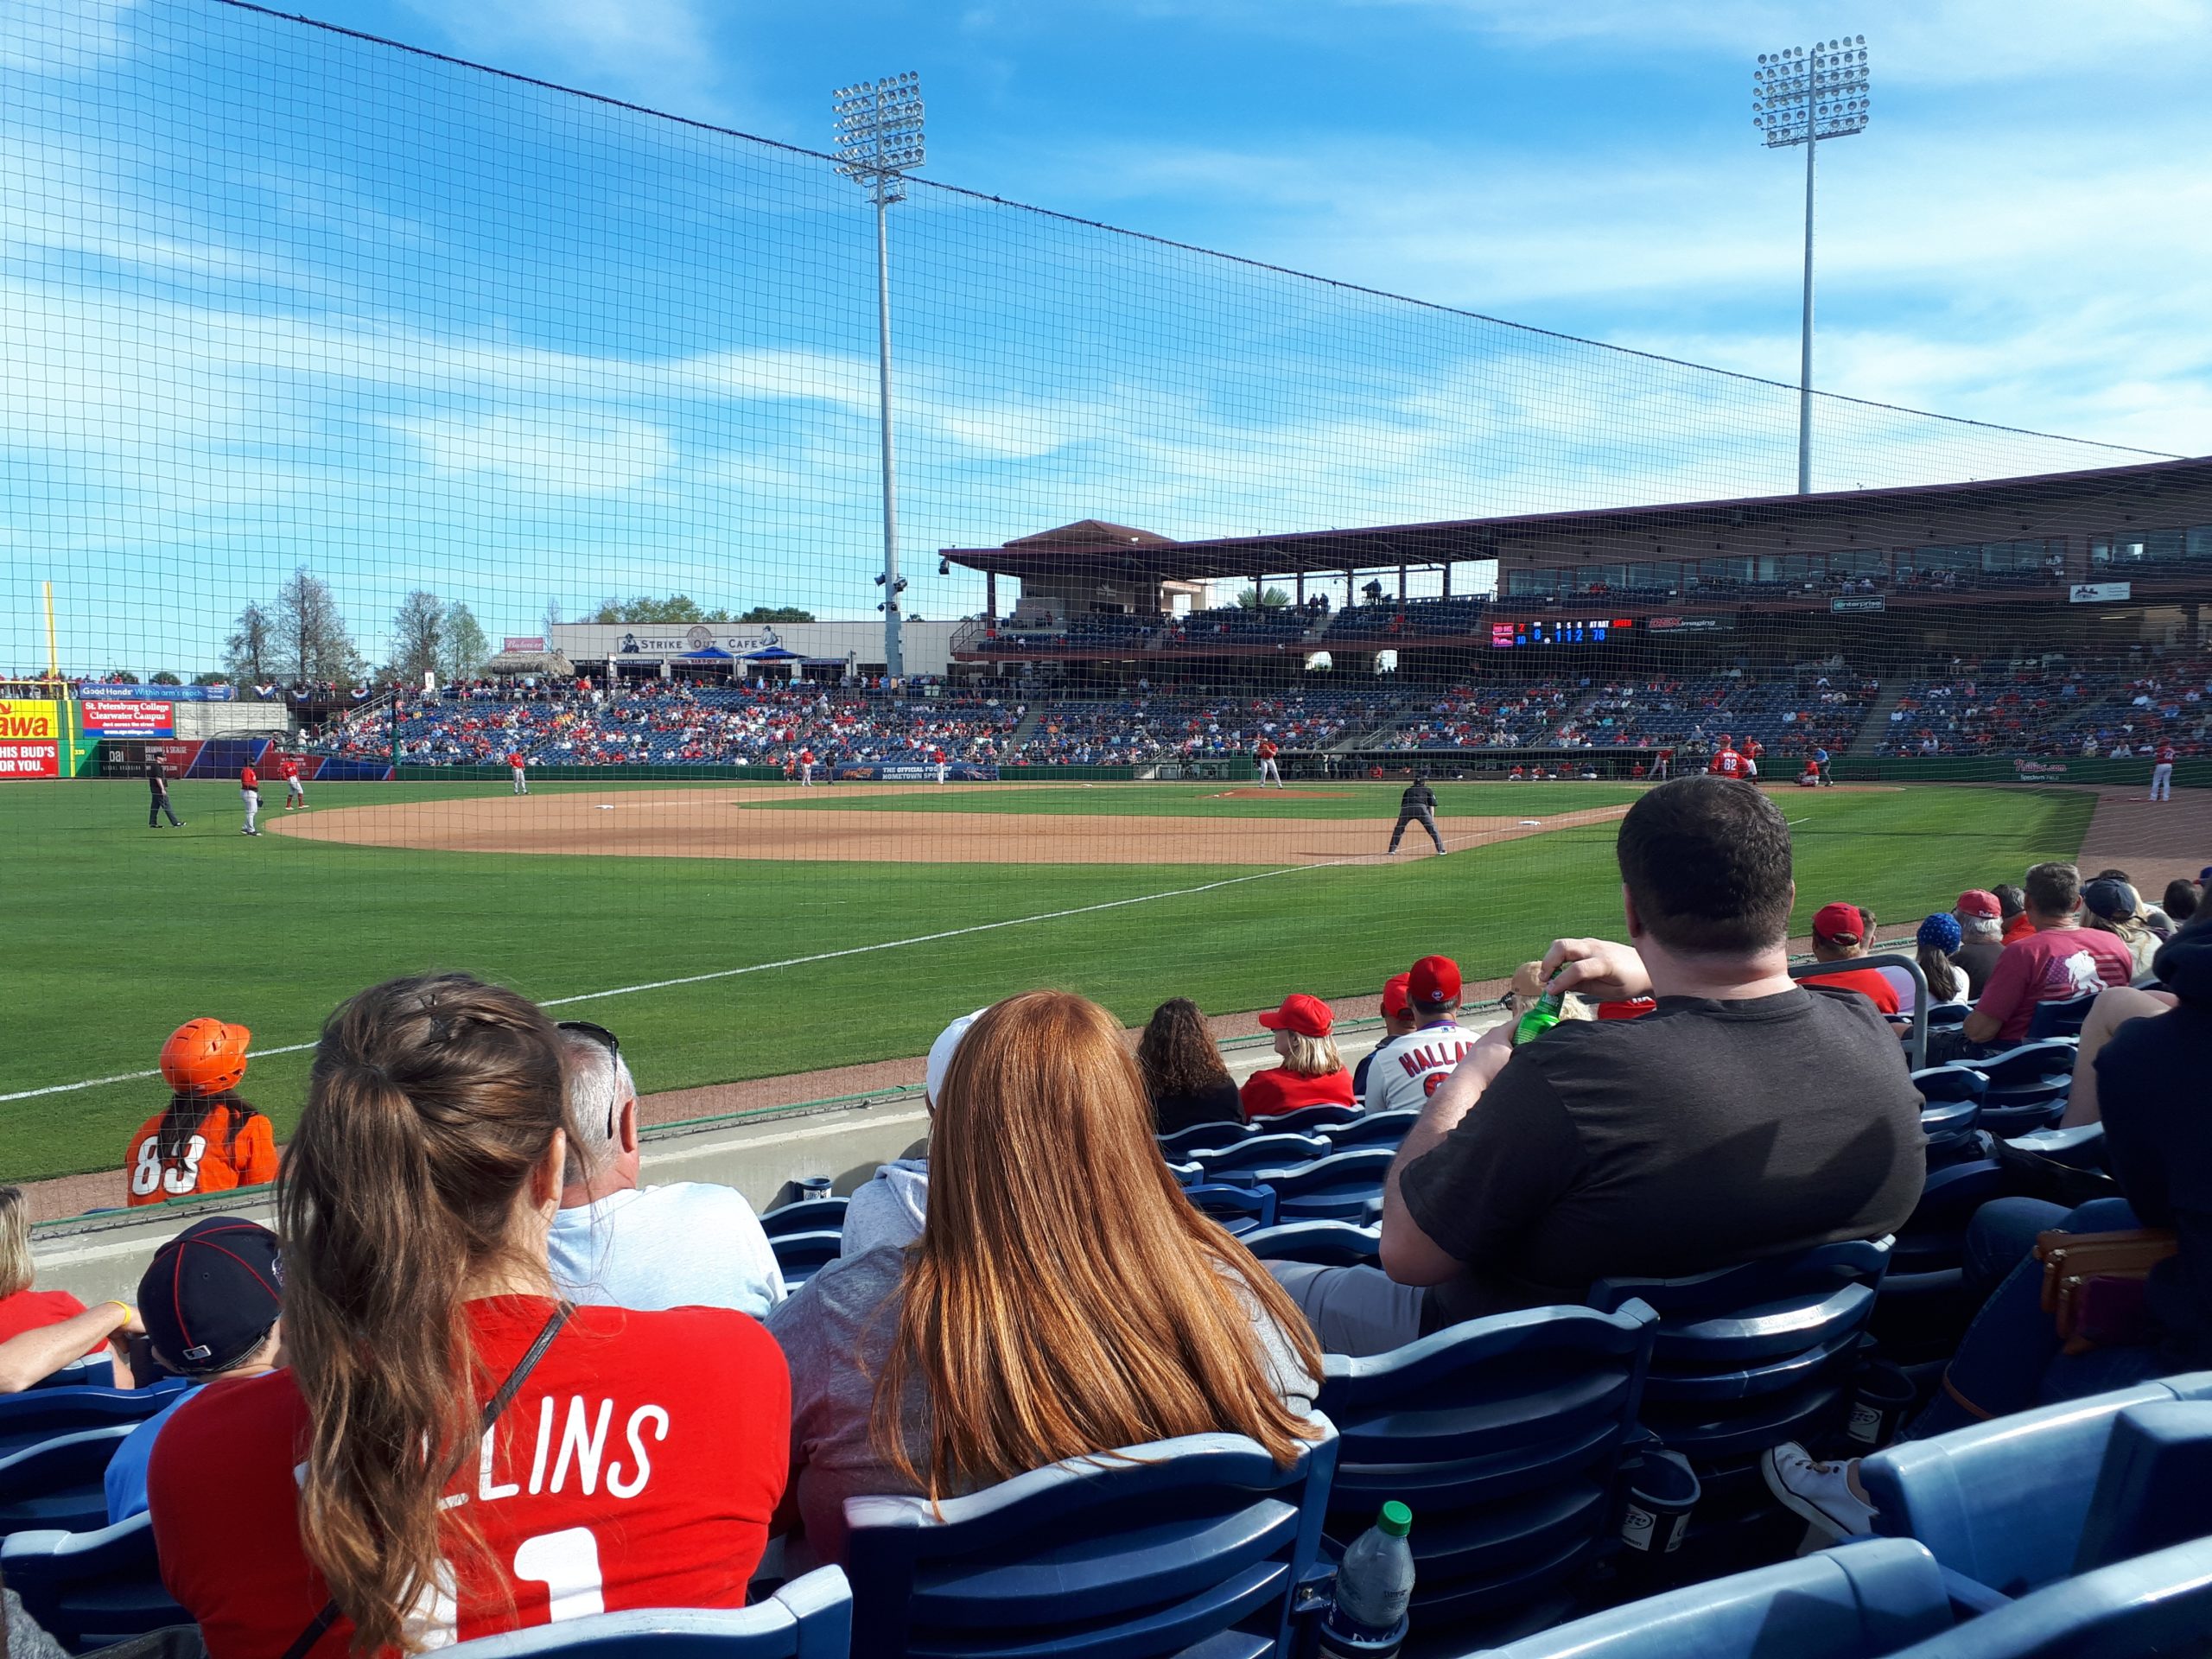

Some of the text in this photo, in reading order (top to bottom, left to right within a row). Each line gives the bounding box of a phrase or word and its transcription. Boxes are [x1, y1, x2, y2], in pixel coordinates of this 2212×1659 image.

[1519, 624, 1525, 632] 2
[1535, 629, 1541, 639] 8
[1516, 635, 1527, 645] 10
[1556, 630, 1561, 642] 1
[1567, 629, 1572, 641] 1
[1575, 629, 1583, 642] 2
[1592, 629, 1605, 640] 78
[641, 639, 683, 649] STRIKE
[728, 639, 758, 648] CAFE
[83, 687, 105, 696] Good
[135, 688, 160, 696] Within
[98, 702, 139, 712] Petersburg
[140, 702, 168, 712] College
[90, 711, 165, 721] Clearwater Campus
[0, 717, 48, 736] awa
[0, 746, 55, 758] HIS BUD'S
[0, 760, 44, 772] OR YOU.
[1724, 759, 1738, 771] 62
[2014, 759, 2067, 772] Phillies.com
[131, 1134, 207, 1196] 83
